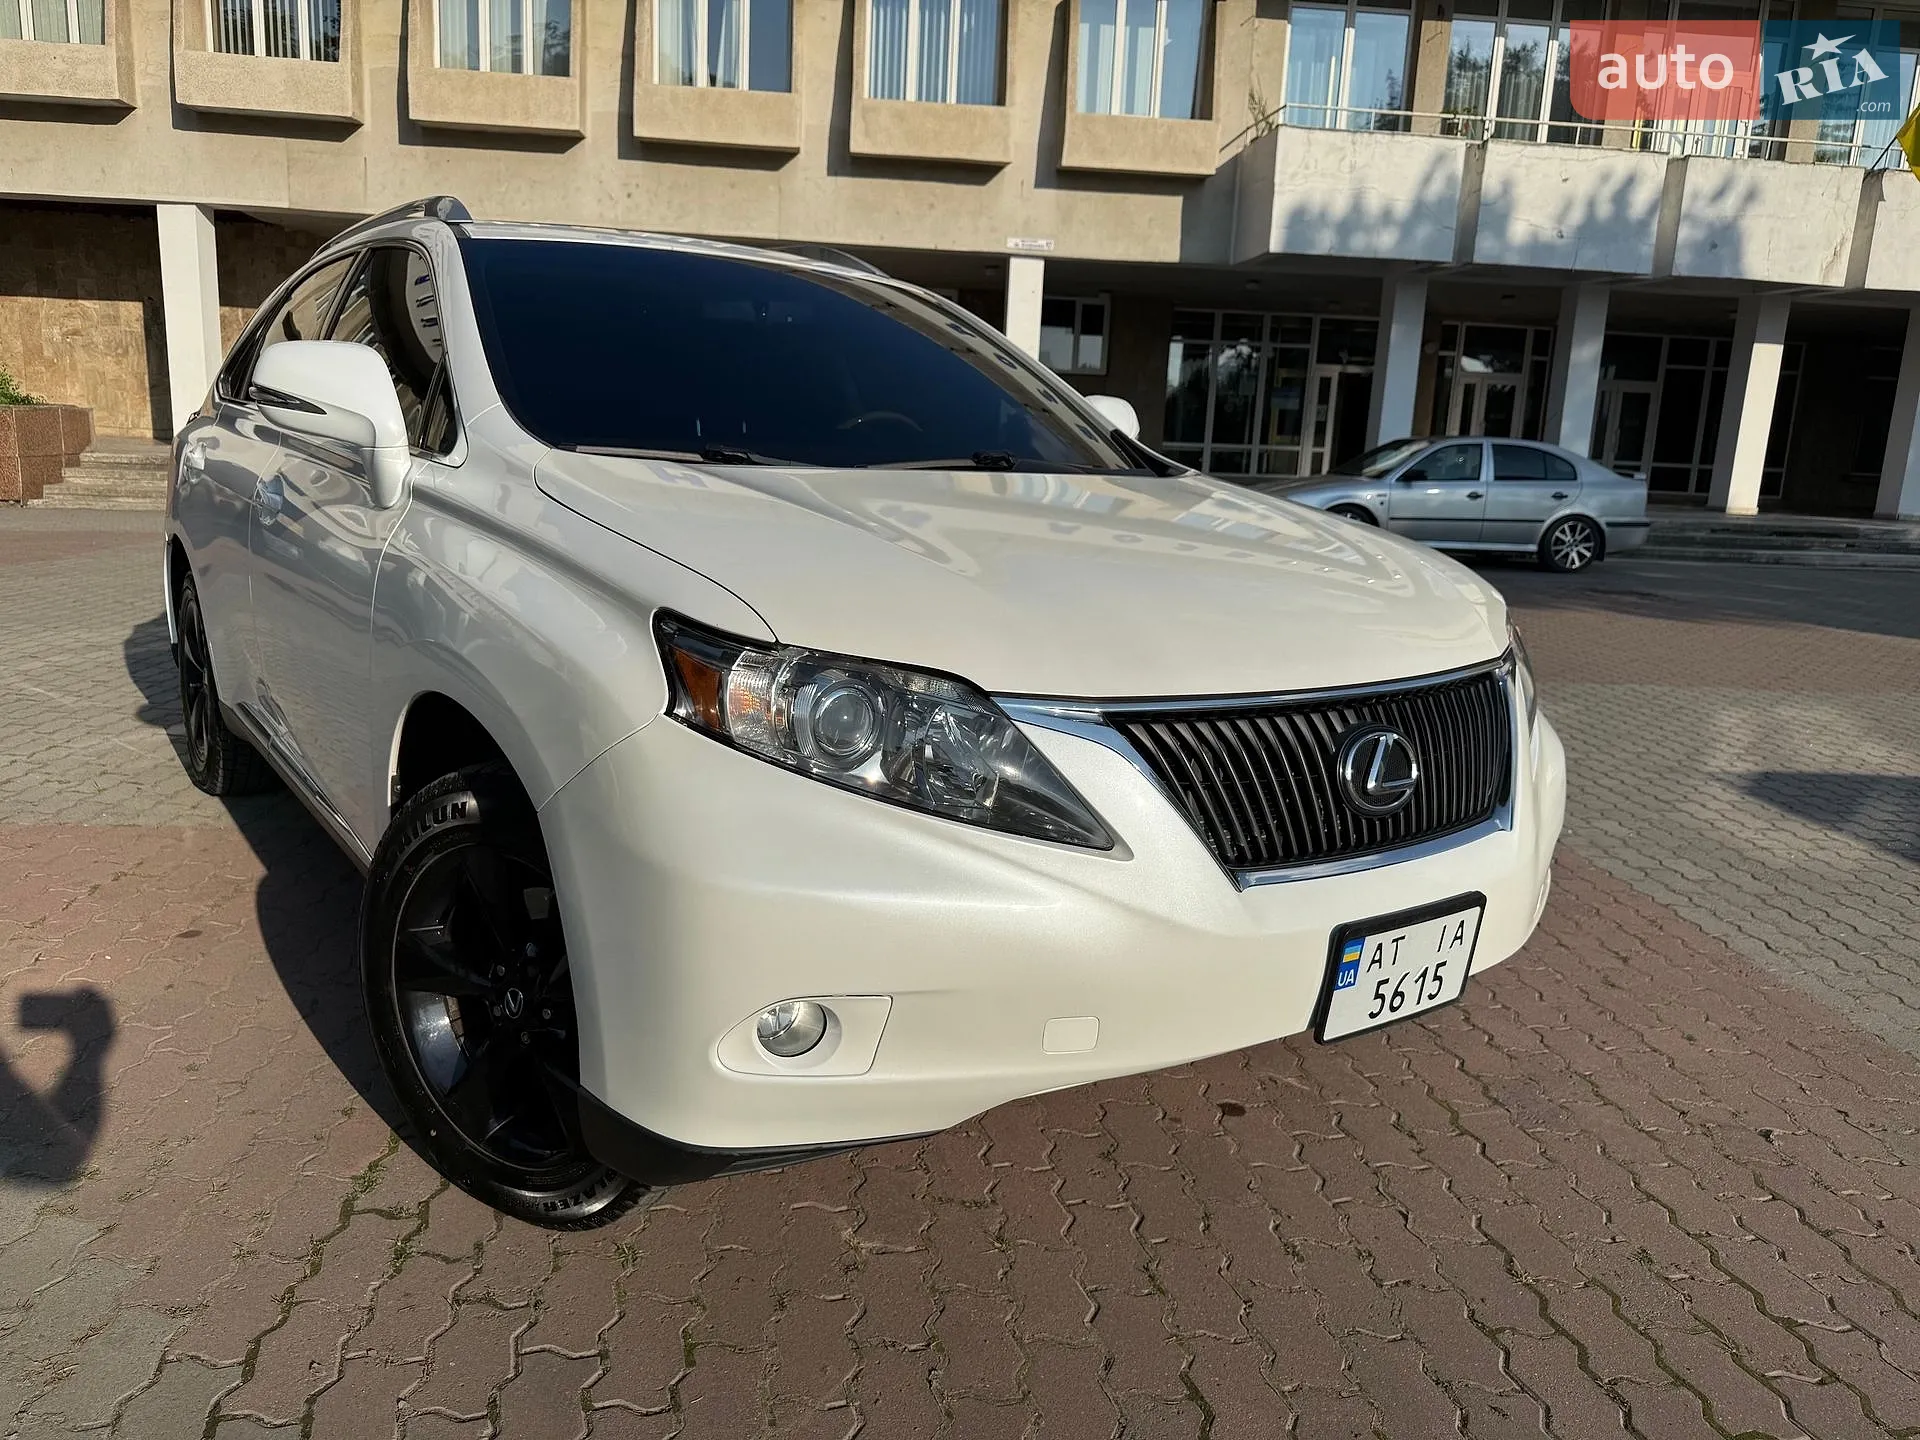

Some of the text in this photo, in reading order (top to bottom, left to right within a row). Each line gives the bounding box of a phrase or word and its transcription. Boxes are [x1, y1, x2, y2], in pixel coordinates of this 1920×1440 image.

[1366, 920, 1465, 973] AT IA
[1338, 969, 1355, 987] UA
[1368, 960, 1448, 1019] 5615
